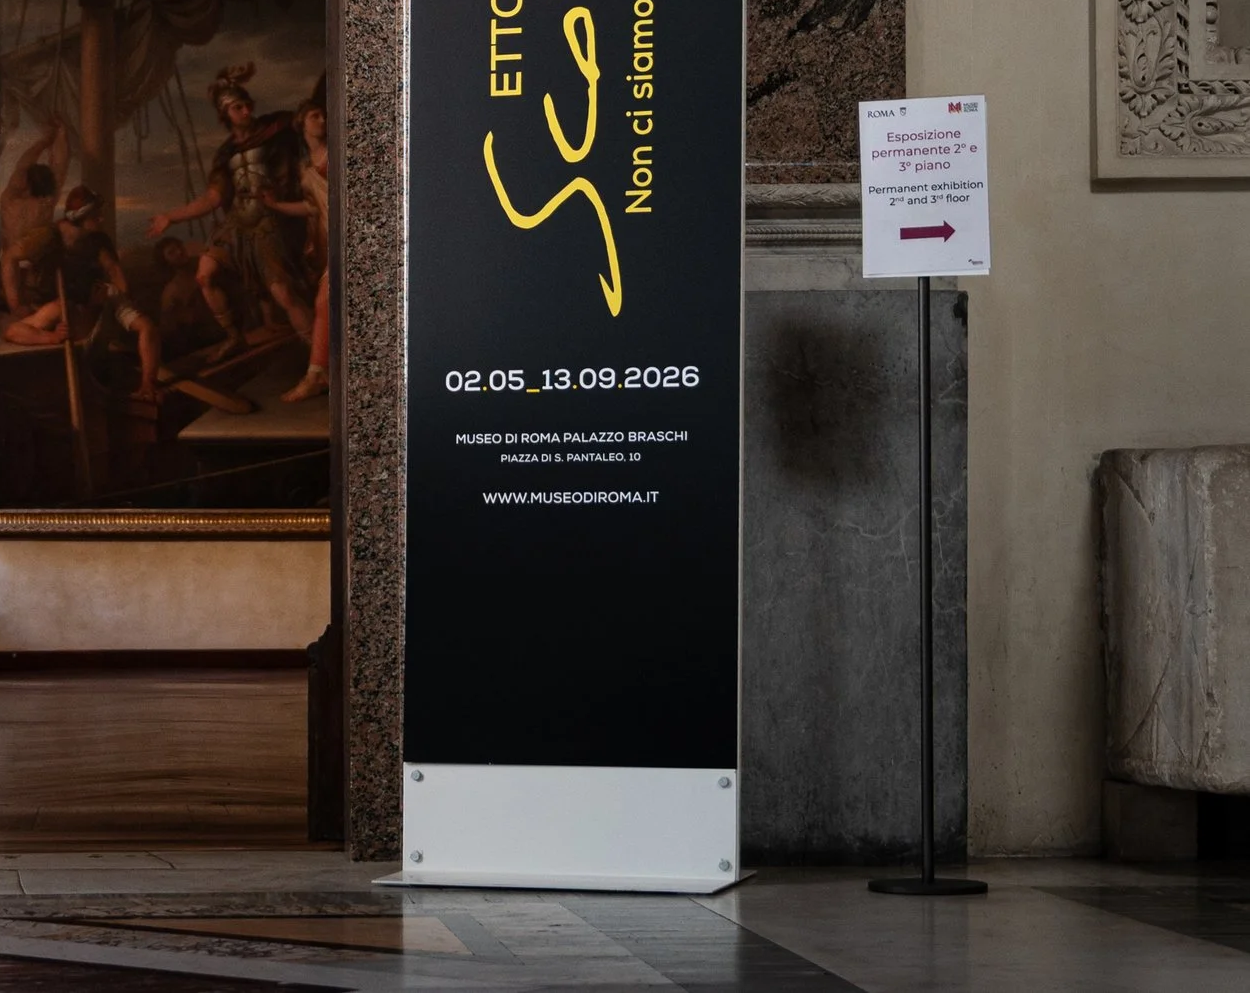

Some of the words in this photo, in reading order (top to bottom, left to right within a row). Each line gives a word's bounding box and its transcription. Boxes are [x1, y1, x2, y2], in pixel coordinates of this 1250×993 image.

[867, 109, 895, 119] ROMA
[626, 109, 654, 136] ci
[886, 129, 961, 144] Esposizione
[871, 145, 950, 161] permanente
[969, 144, 978, 153] e
[915, 160, 951, 173] piano
[624, 145, 654, 214] Non
[868, 183, 929, 194] Permanent
[931, 180, 984, 192] exhibition
[889, 196, 905, 206] 2nd
[907, 195, 928, 205] and
[930, 194, 944, 204] 3rd
[945, 193, 970, 203] floor
[445, 366, 700, 393] 02.05_13.09.2026
[456, 433, 502, 445] MUSEO
[505, 433, 518, 444] DI
[521, 432, 561, 444] ROMA
[563, 431, 625, 443] PALAZZO
[628, 430, 688, 443] BRASCHI
[500, 454, 539, 463] PIAZZA
[542, 453, 552, 463] DI
[554, 453, 564, 462] S.
[566, 452, 626, 463] PANTALEO,
[629, 452, 642, 462] 10
[483, 491, 660, 504] WWW.MUSEODIROMA.IT
